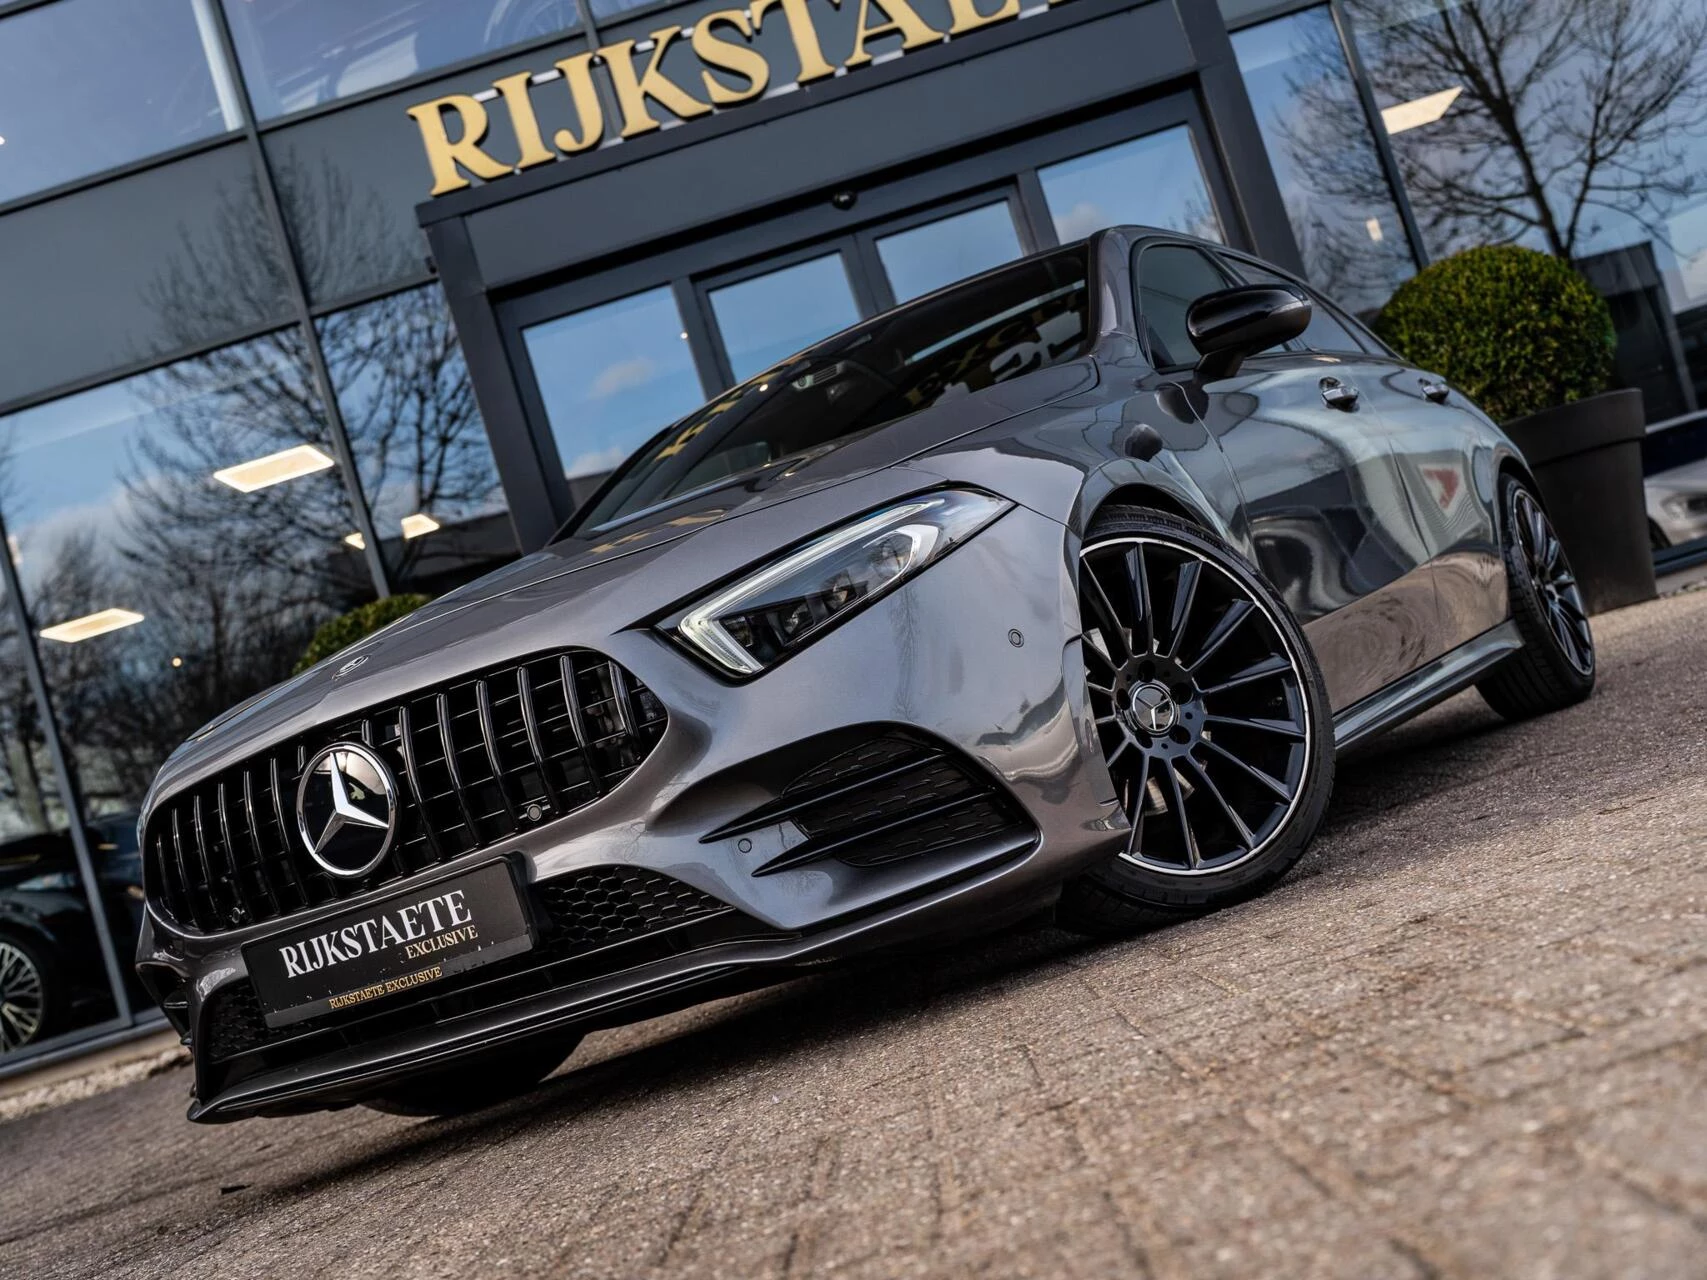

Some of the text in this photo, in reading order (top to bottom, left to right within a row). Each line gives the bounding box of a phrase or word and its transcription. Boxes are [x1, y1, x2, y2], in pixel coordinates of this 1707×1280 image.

[279, 890, 472, 978] RIJKSTAETE
[405, 925, 478, 960] EXCLUSIVE
[329, 966, 443, 1009] RIJKSTAETE EXCLUSIVE
